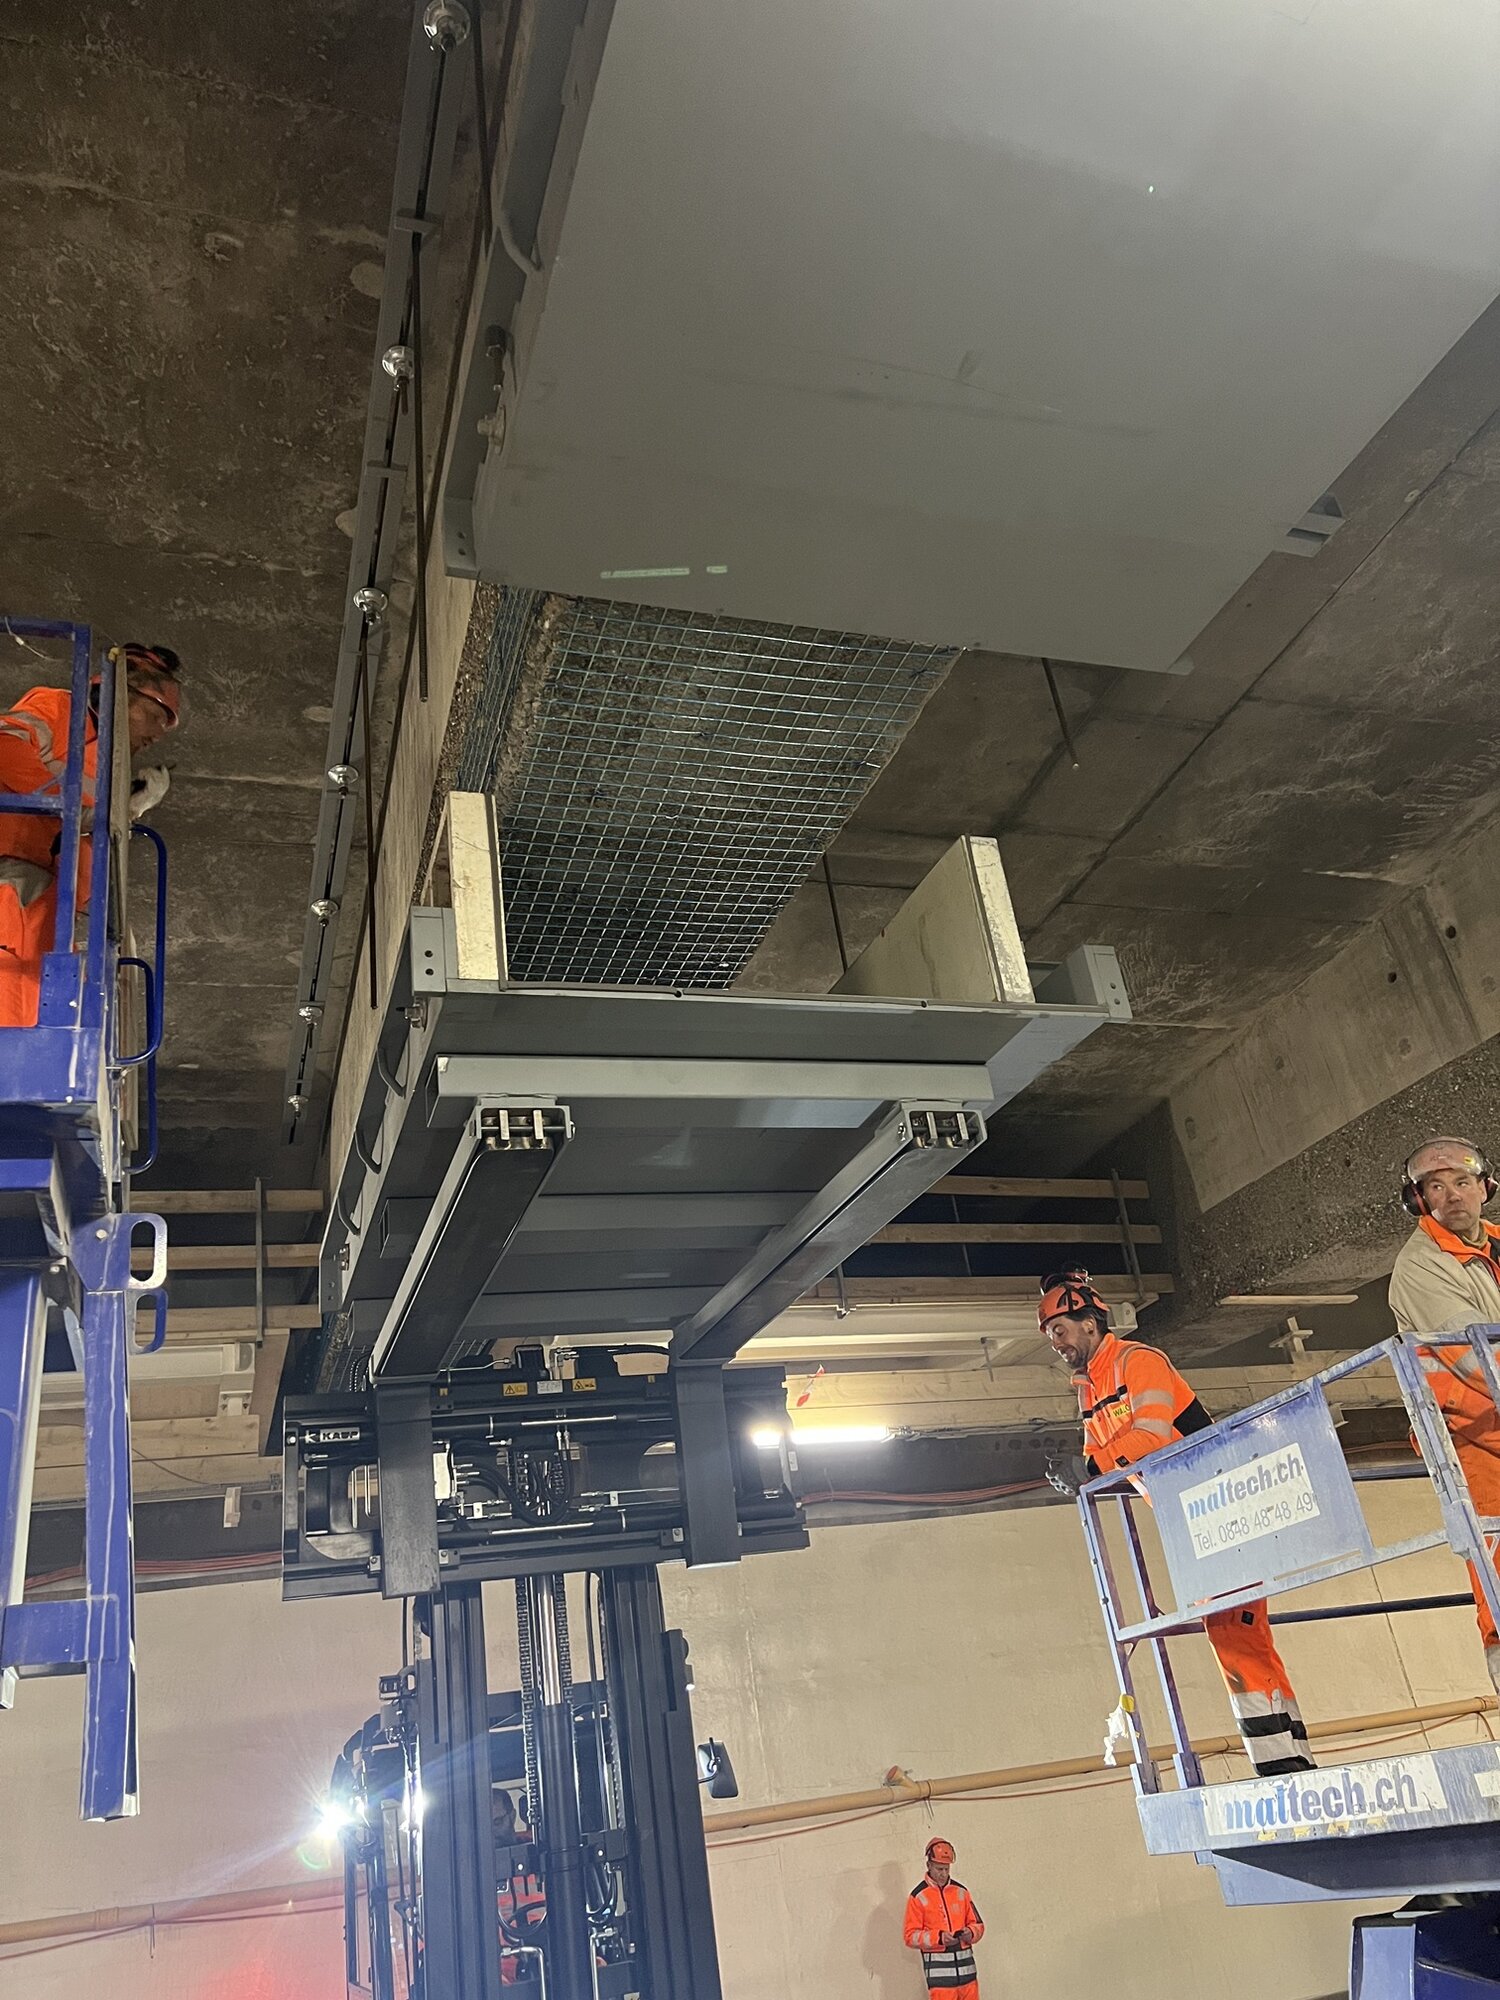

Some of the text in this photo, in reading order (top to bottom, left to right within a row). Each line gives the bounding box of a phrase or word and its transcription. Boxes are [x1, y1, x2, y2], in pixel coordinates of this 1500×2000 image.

[322, 1430, 359, 1441] KAUP
[1187, 1453, 1302, 1520] maltech.ch
[1194, 1492, 1314, 1551] Tel. 0848 48 48 49
[1224, 1767, 1418, 1830] maltech.ch
